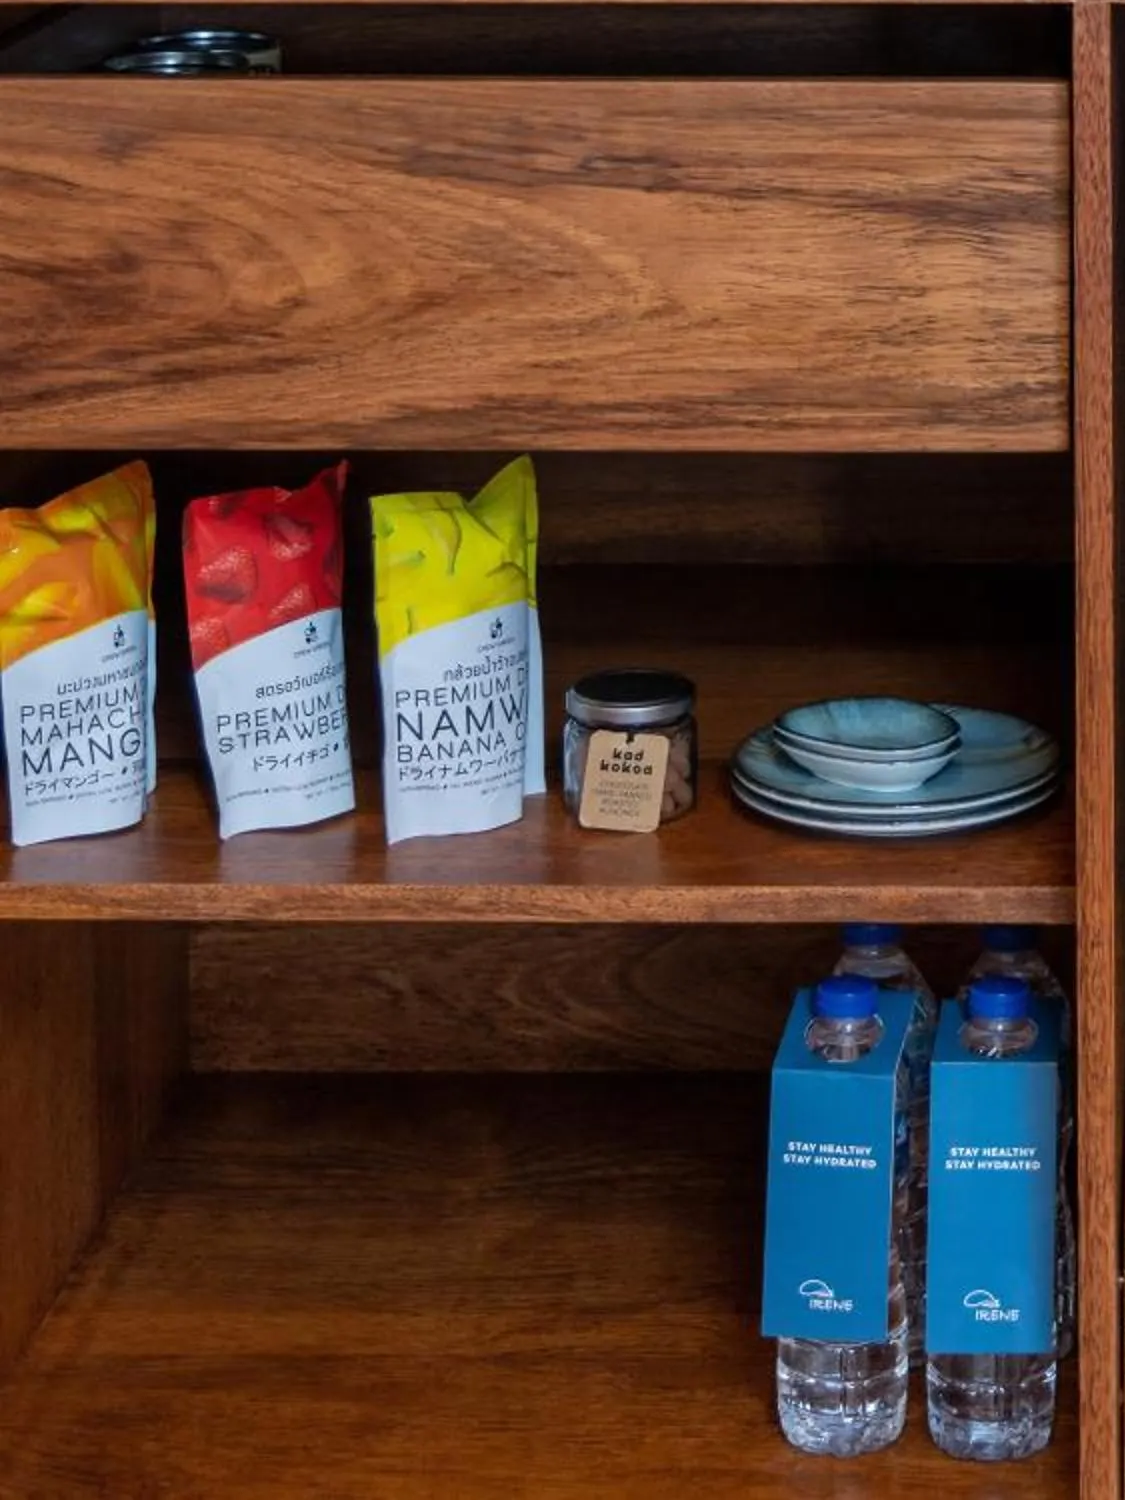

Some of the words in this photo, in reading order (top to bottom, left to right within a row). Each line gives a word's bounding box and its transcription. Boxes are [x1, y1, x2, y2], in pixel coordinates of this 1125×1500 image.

[20, 682, 140, 725] PREMIUM
[395, 673, 511, 709] PREMIUM
[21, 706, 142, 748] MAHACH
[216, 691, 331, 734] PREMIUM
[22, 727, 142, 777] MANG
[253, 743, 329, 772] ドライイチゴ
[397, 731, 507, 763] BANANA
[613, 747, 645, 761] kad
[600, 759, 653, 775] kokoa
[783, 1153, 812, 1165] STAY
[814, 1156, 877, 1170] HYDRATED
[788, 1141, 817, 1153] STAY
[819, 1143, 872, 1156] HEALTHY
[950, 1147, 979, 1158] STAY
[982, 1147, 1036, 1158] HEALTHY
[945, 1159, 975, 1170] STAY
[977, 1160, 1041, 1171] HYDRATED
